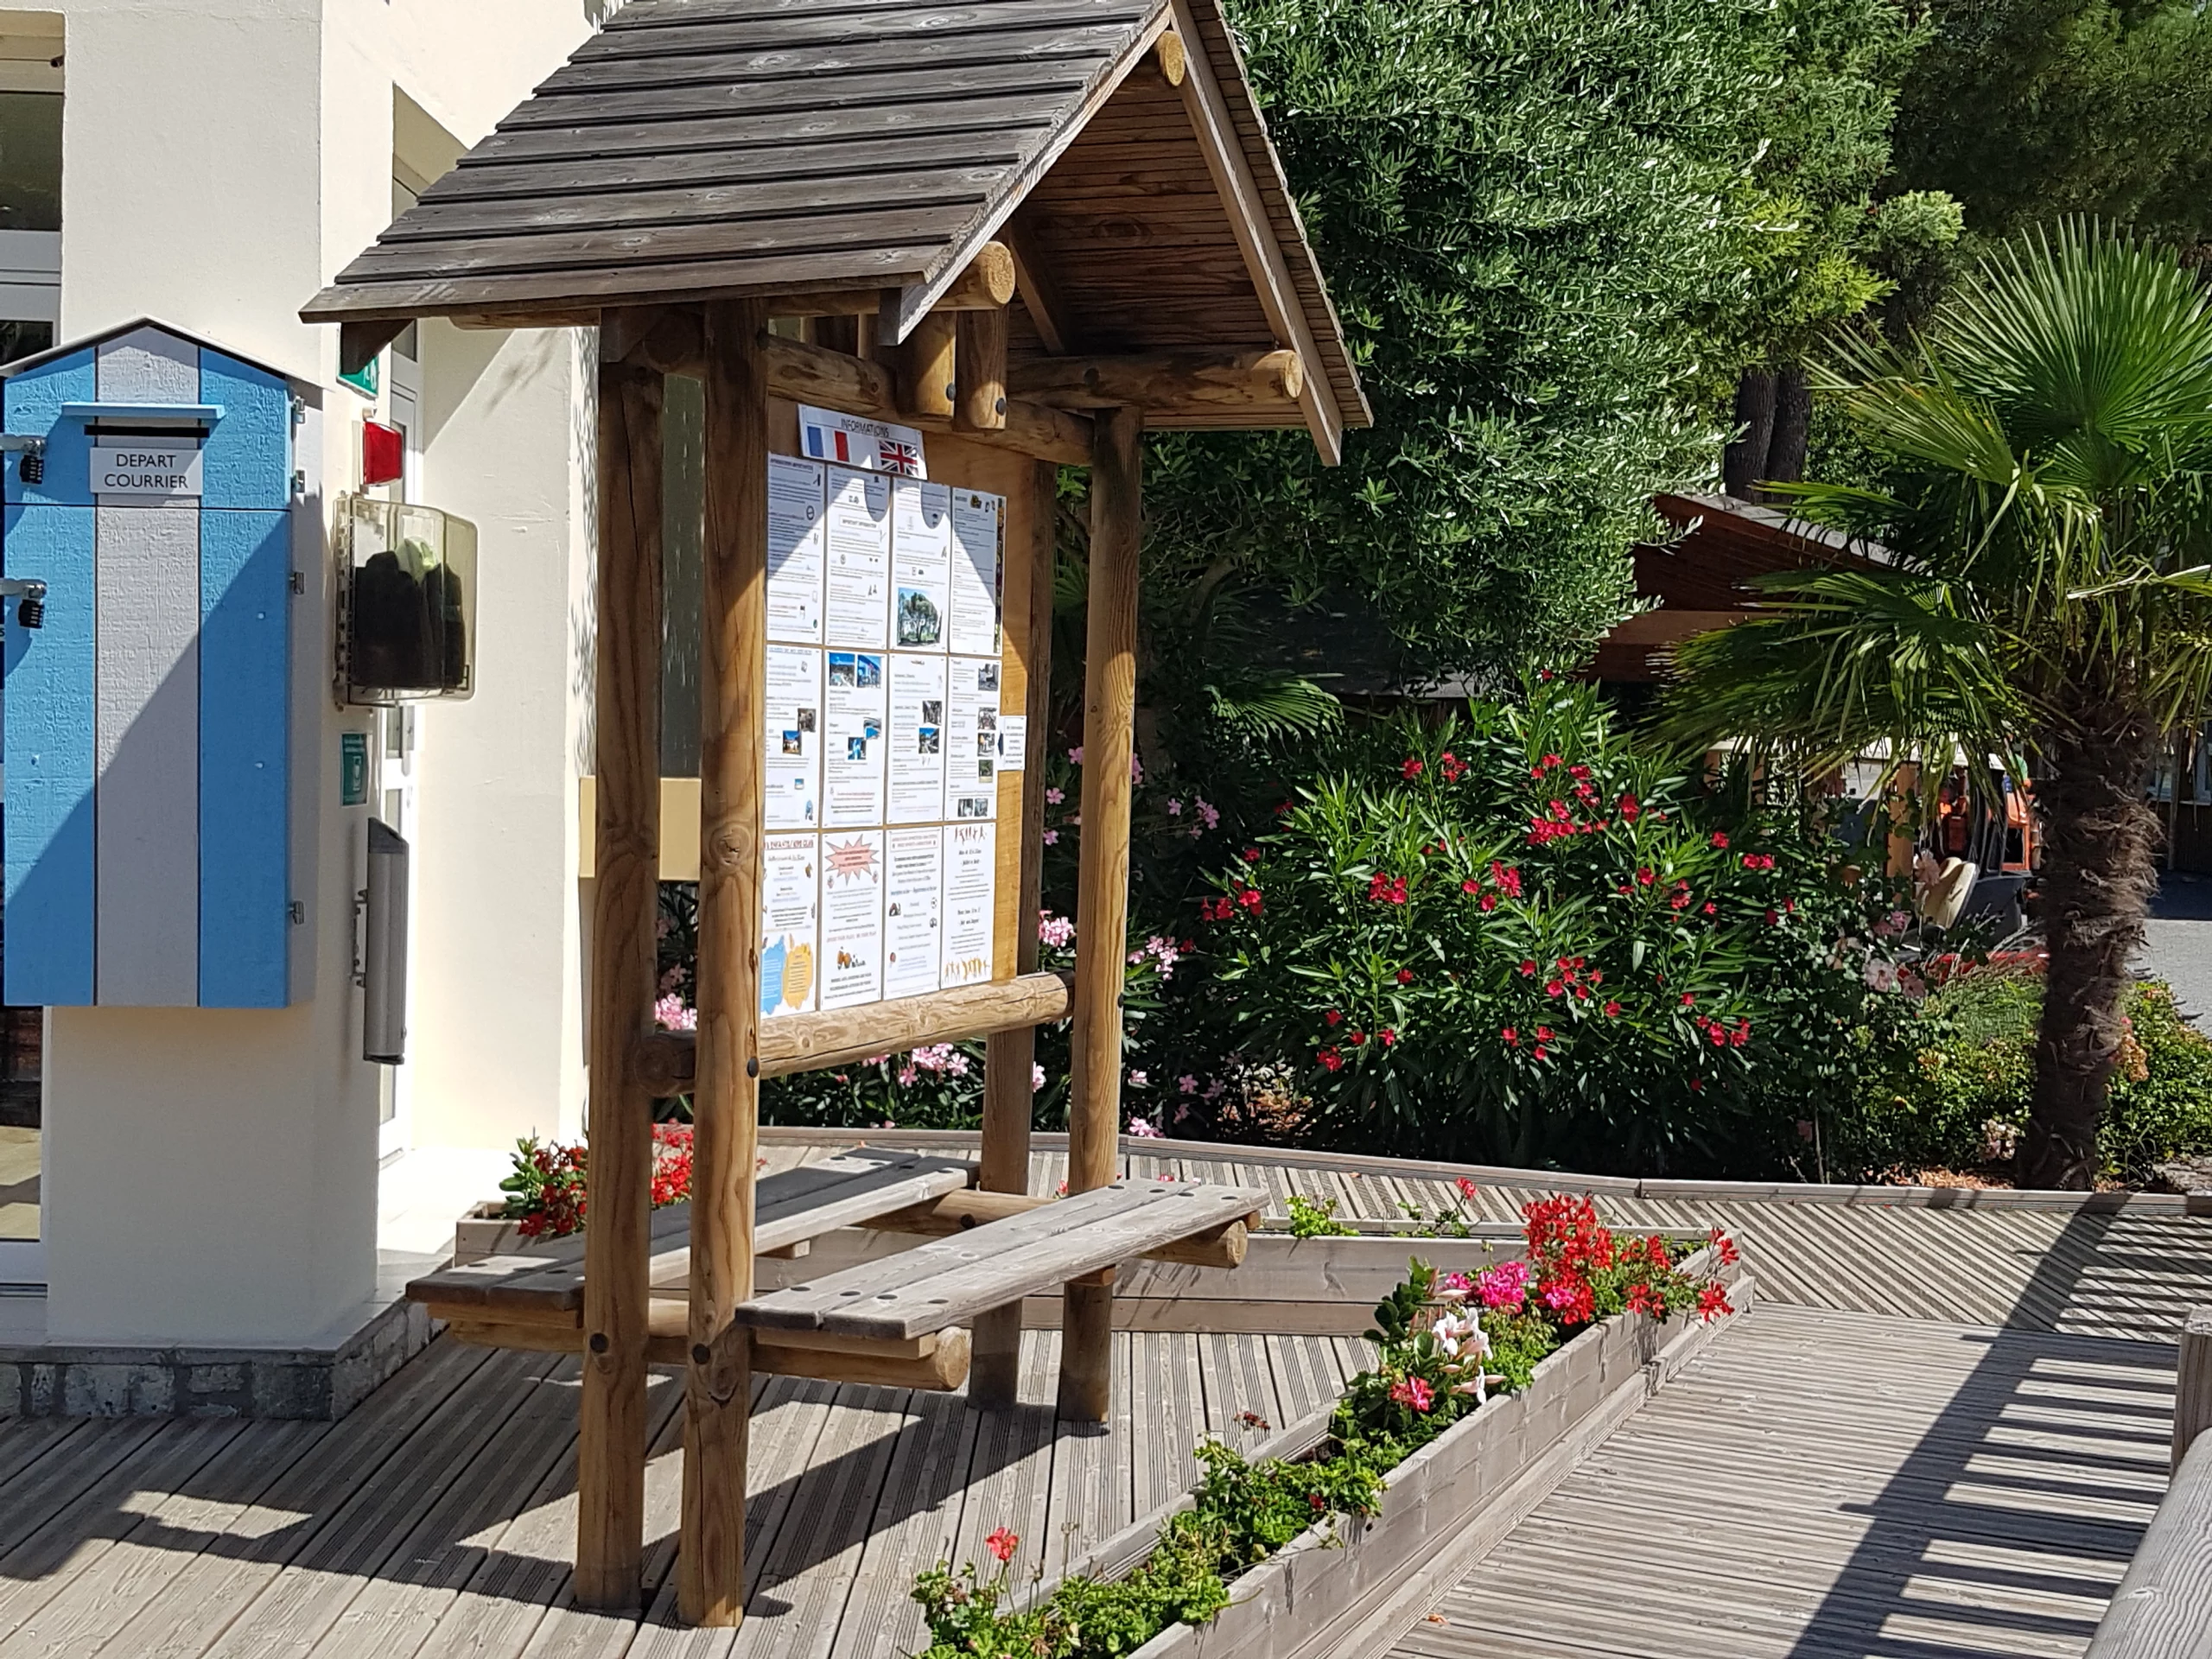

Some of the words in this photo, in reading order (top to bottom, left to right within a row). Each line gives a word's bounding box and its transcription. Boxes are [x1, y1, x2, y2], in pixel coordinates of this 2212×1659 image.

[841, 418, 889, 438] INFORMATIONS
[116, 454, 177, 467] DEPART
[104, 474, 188, 489] COURRIER
